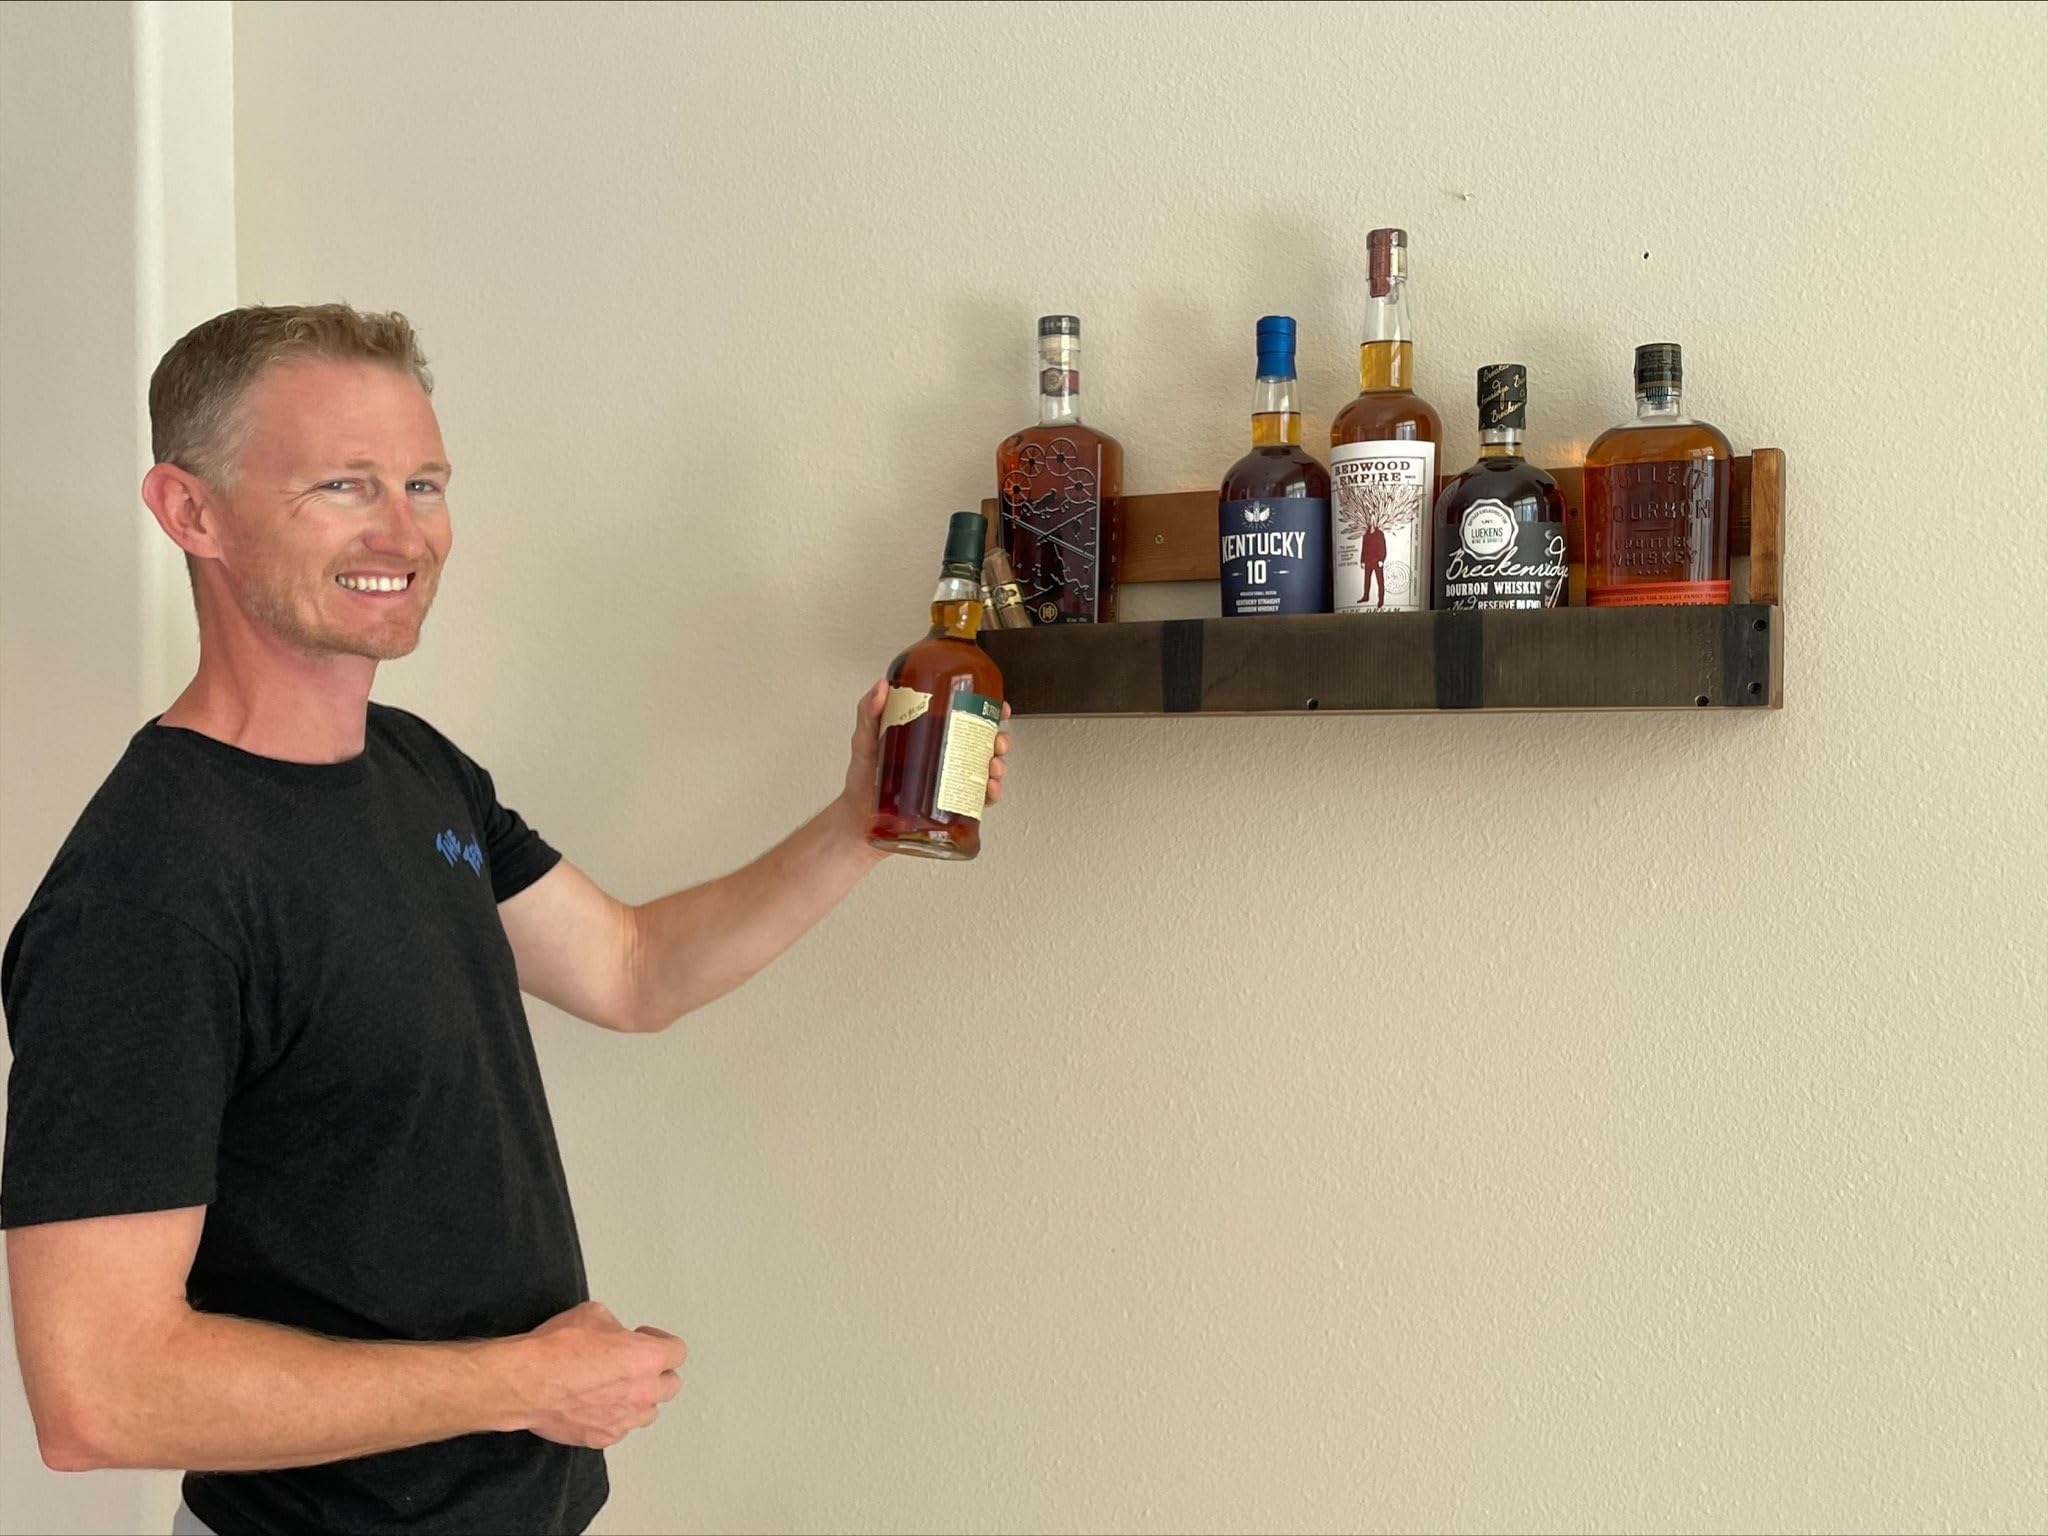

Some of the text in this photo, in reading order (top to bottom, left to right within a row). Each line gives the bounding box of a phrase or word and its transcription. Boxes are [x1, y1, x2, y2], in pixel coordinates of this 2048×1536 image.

[1340, 472, 1401, 486] EMPIRE
[1470, 527, 1504, 539] LUEKENS
[1222, 531, 1305, 564] KENTUCKY
[1247, 559, 1267, 585] 10
[1446, 535, 1569, 609] Breckenridge
[1445, 581, 1542, 597] BOURBON WHISKEY
